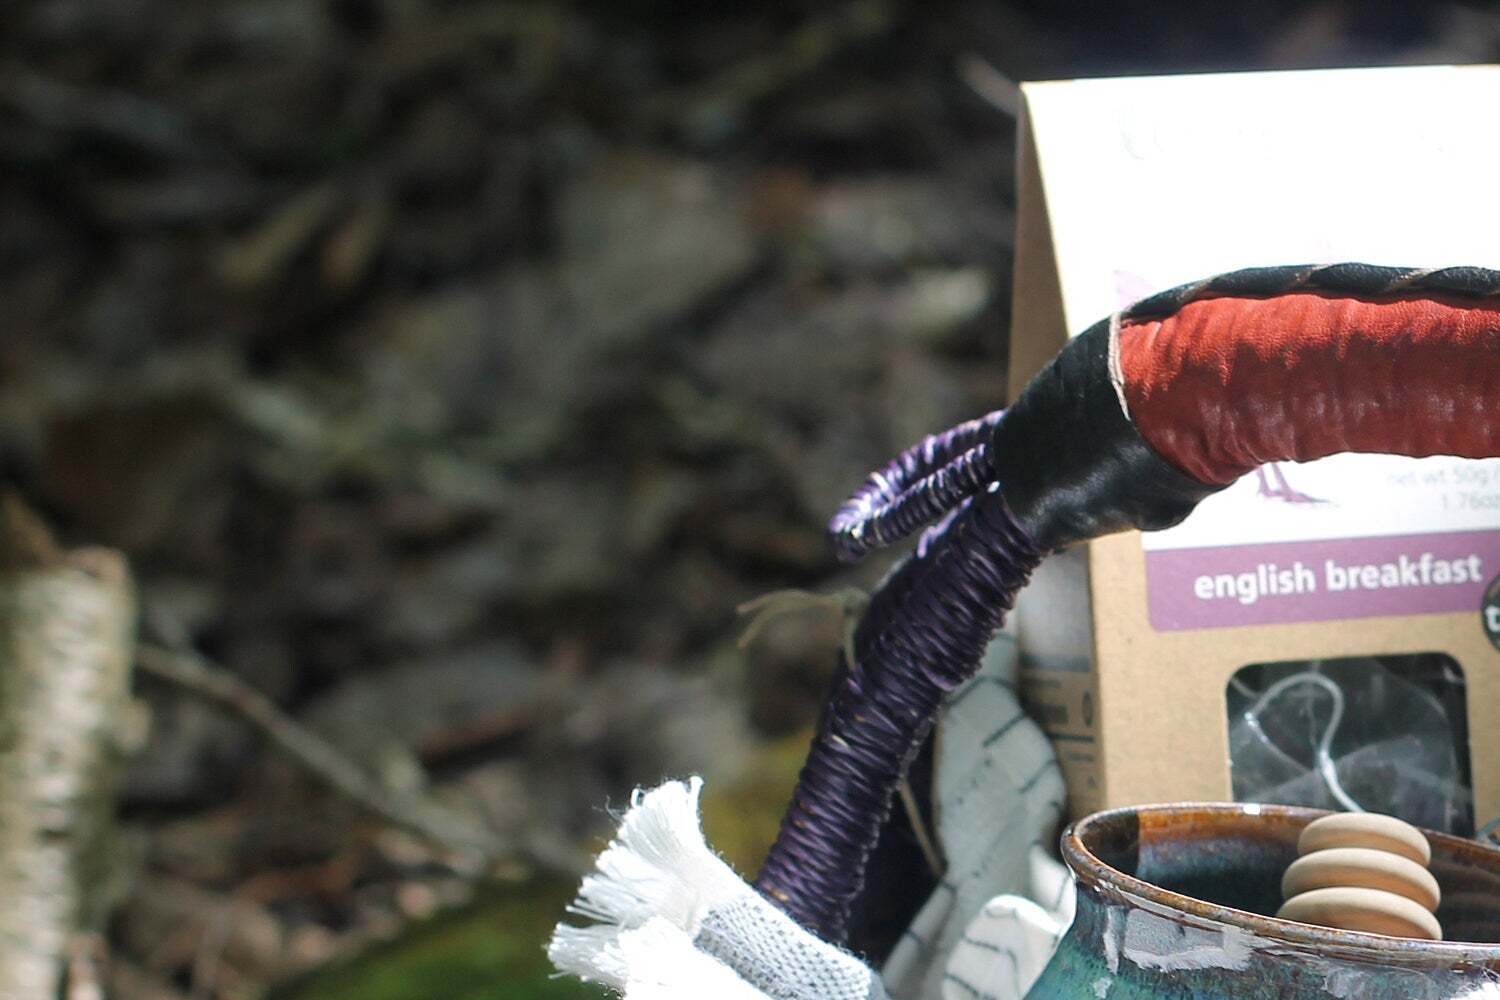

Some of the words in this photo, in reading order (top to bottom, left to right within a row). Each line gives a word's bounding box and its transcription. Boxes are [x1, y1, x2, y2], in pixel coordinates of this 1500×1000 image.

[1452, 463, 1489, 487] 50g
[1194, 560, 1316, 605] english
[1326, 553, 1483, 594] breakfast
